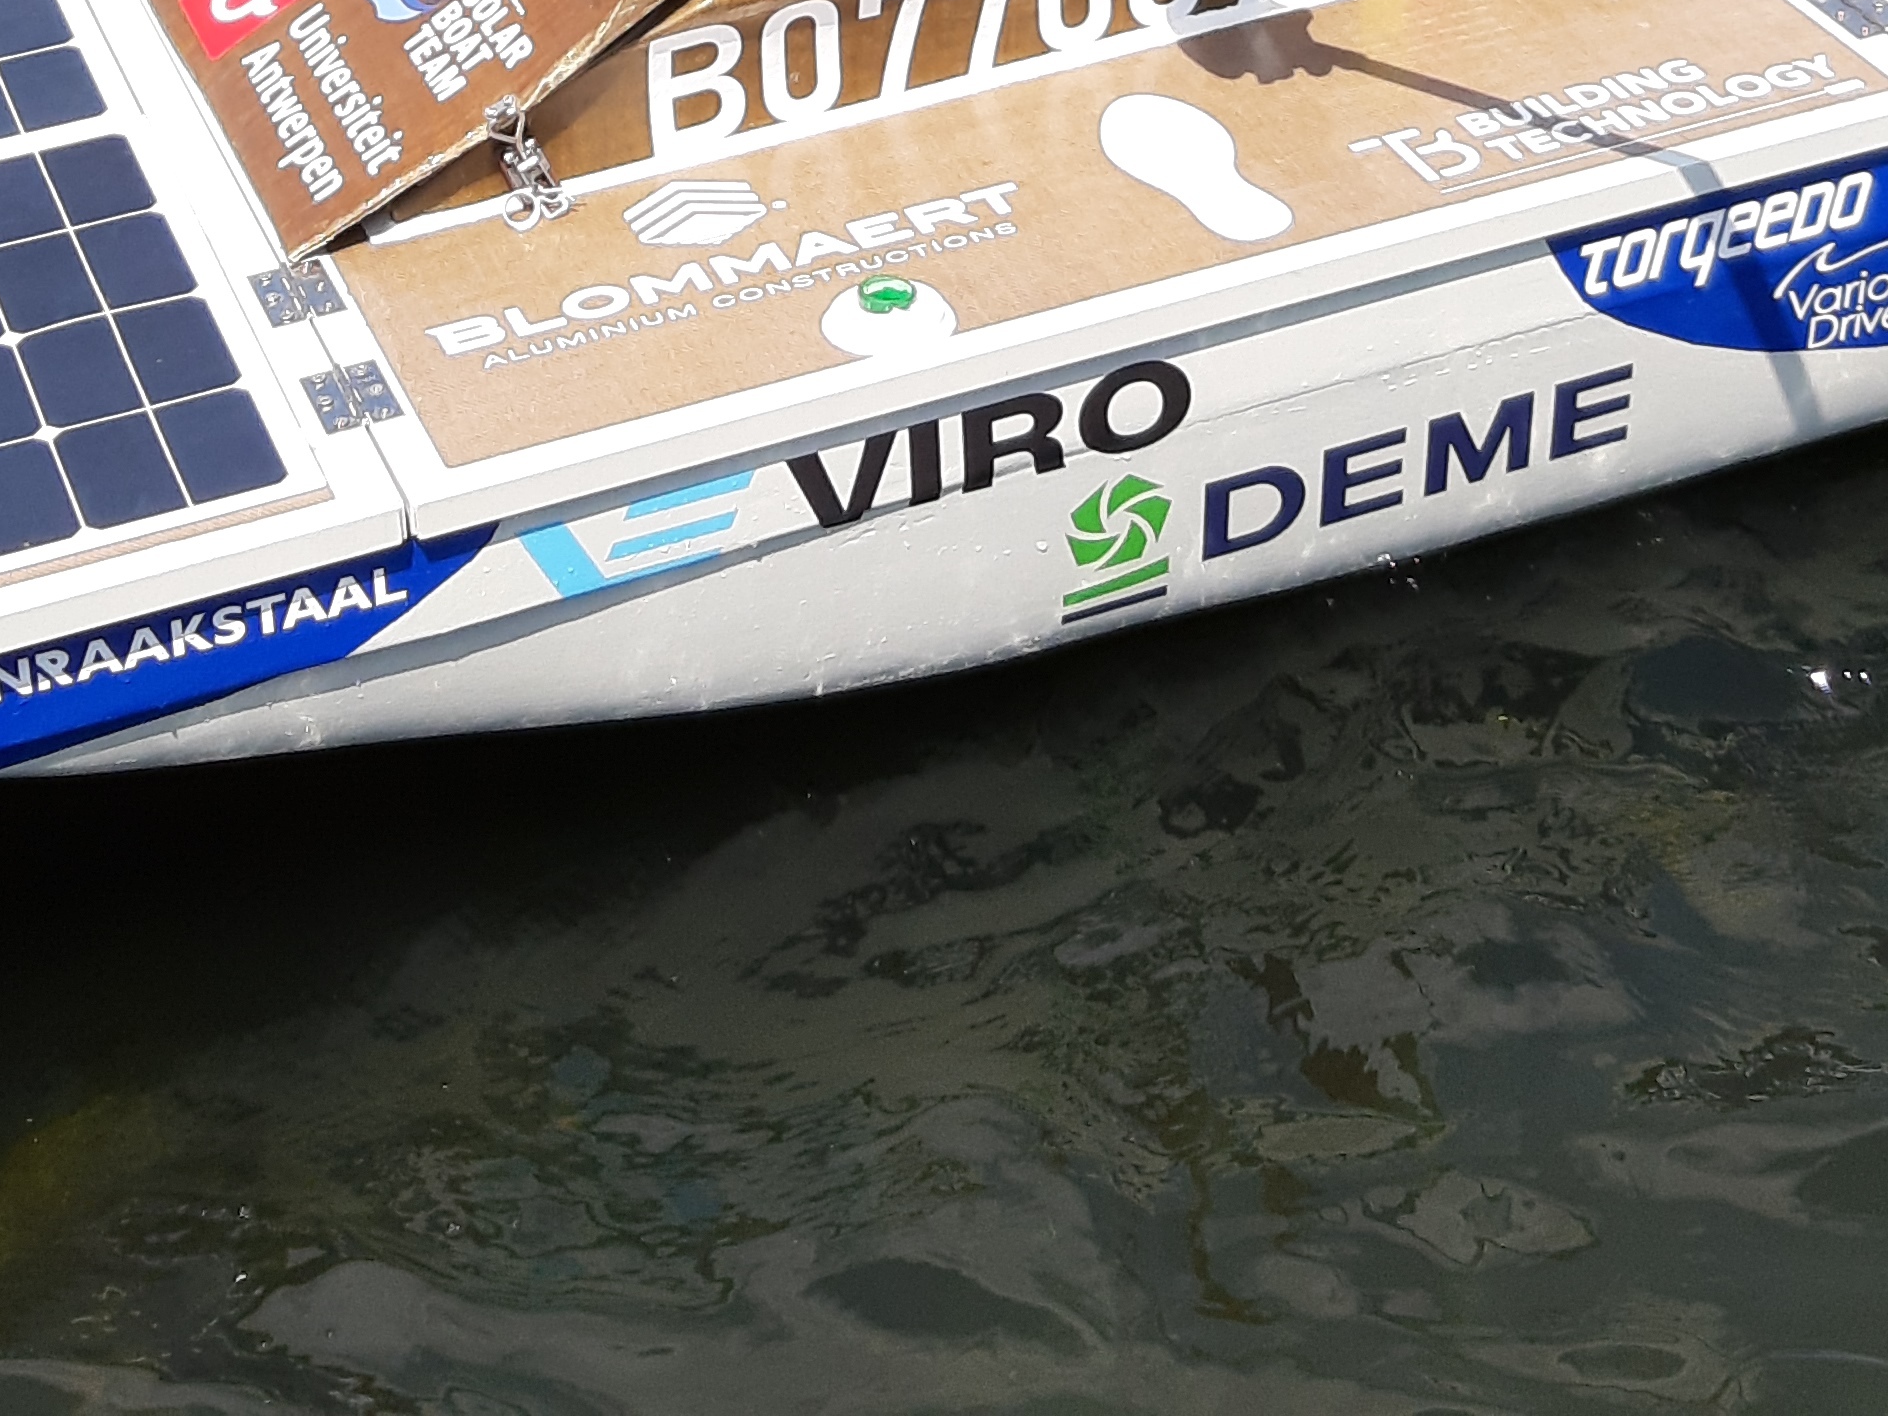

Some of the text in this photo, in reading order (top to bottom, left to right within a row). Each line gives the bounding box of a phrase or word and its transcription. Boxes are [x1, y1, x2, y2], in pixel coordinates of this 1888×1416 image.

[287, 1, 404, 179] Universiteit
[403, 22, 468, 104] TEAM
[430, 0, 494, 71] BOAT
[1455, 58, 1708, 138] BUILDING
[1483, 54, 1837, 164] TECHNOLOGY
[240, 39, 344, 205] Antwerpen
[424, 181, 1020, 357] BLOMMAERT
[483, 219, 1020, 369] ALUMINIUM CONSTRUCTIONS
[784, 359, 1192, 529] VIRO
[1202, 363, 1634, 562] DEME
